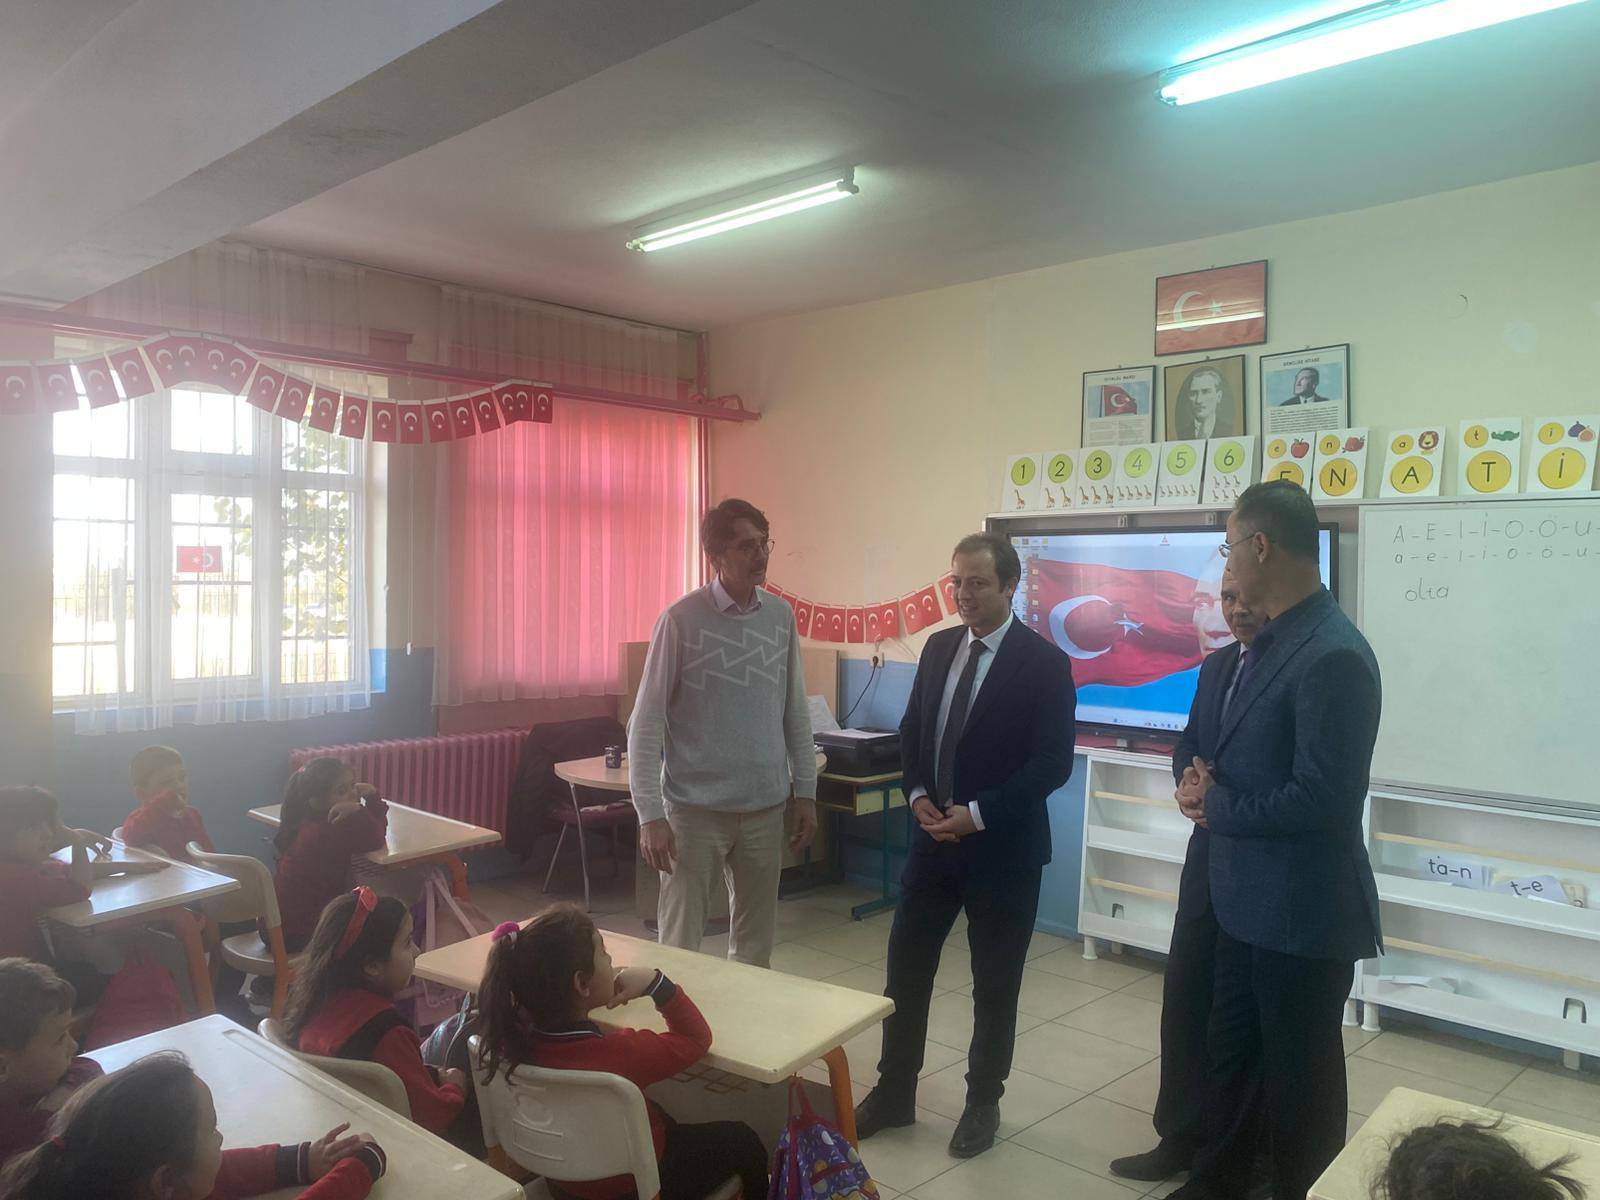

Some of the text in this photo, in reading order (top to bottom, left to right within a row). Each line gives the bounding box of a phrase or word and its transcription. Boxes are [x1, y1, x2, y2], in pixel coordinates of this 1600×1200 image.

[1473, 429, 1479, 441] t
[1273, 445, 1281, 453] e
[1325, 441, 1333, 449] n
[1093, 456, 1103, 474] 3
[1131, 453, 1143, 471] 4
[1174, 450, 1188, 469] 5
[1223, 448, 1235, 467] 6
[1020, 463, 1026, 480] 1
[1054, 460, 1066, 477] 2
[1329, 467, 1347, 487] N
[1401, 466, 1420, 485] A
[1481, 461, 1497, 482] T
[1427, 857, 1473, 880] ta-n
[1510, 880, 1544, 897] t-e
